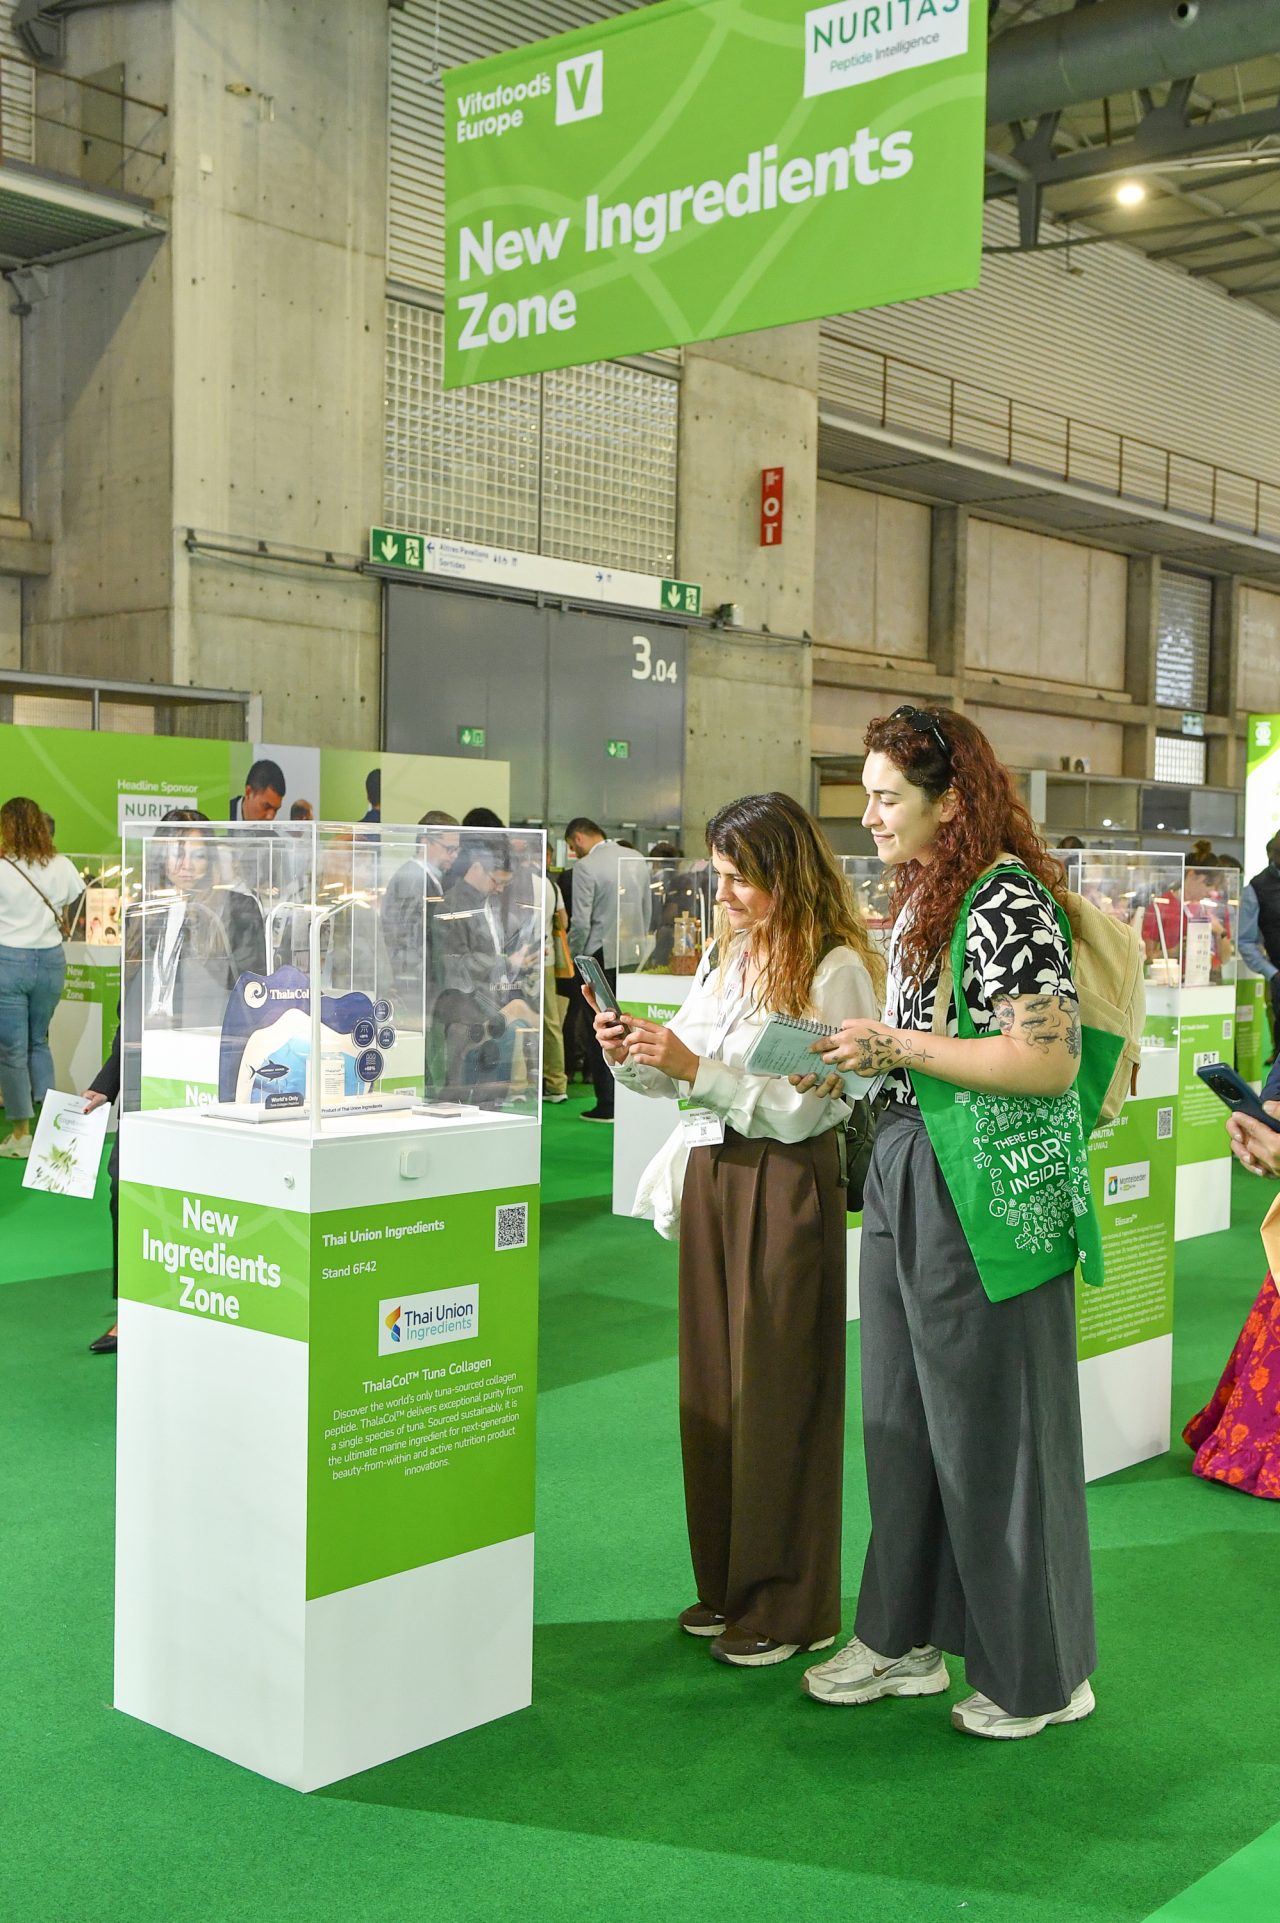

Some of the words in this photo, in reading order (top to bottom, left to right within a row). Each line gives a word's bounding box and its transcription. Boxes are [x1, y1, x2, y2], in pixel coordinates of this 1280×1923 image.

[830, 51, 873, 72] Peptide
[875, 32, 940, 60] Intelligence
[457, 109, 524, 144] Europe
[458, 217, 570, 281] New
[585, 126, 914, 254] Ingredients
[457, 289, 577, 351] Zone
[631, 635, 678, 683] 3.04
[117, 779, 159, 791] Headline
[161, 781, 198, 793] Sponsor
[66, 965, 84, 976] New
[66, 989, 84, 1000] Zone
[647, 1004, 676, 1020] New
[1203, 1053, 1216, 1064] PLT
[993, 1132, 1027, 1151] THERE
[1028, 1129, 1039, 1140] IS
[1040, 1127, 1047, 1137] A
[1009, 1161, 1066, 1195] INSIDE
[182, 1197, 239, 1238] New
[322, 1231, 347, 1247] Thai
[349, 1228, 382, 1243] Union
[385, 1219, 445, 1239] Ingredients
[142, 1228, 282, 1288] Ingredients
[322, 1264, 350, 1279] Stand
[352, 1260, 377, 1275] 6F42
[179, 1275, 240, 1320] Zone
[404, 1307, 433, 1326] Thai
[436, 1302, 473, 1321] Union
[406, 1319, 472, 1340] Ingredients
[362, 1371, 419, 1393] ThalaCol™
[421, 1368, 446, 1380] Tuna
[449, 1358, 492, 1375] Collagen
[324, 1422, 358, 1440] peptide.
[360, 1410, 405, 1429] ThalaCol™
[406, 1404, 437, 1418] delivers
[439, 1392, 482, 1411] exceptional
[483, 1389, 505, 1403] purity
[506, 1384, 523, 1396] from
[333, 1405, 368, 1421] Discover
[370, 1401, 384, 1412] the
[386, 1393, 415, 1408] world's
[416, 1390, 434, 1402] only
[435, 1379, 484, 1397] tuna-sourced
[485, 1372, 517, 1385] collagen
[328, 1455, 342, 1466] the
[344, 1447, 378, 1462] ultimate
[379, 1439, 407, 1454] marine
[408, 1430, 448, 1447] ingredient
[449, 1426, 460, 1437] for
[461, 1412, 520, 1433] next-generation
[331, 1443, 337, 1451] a
[338, 1434, 363, 1449] single
[365, 1428, 395, 1443] species
[396, 1423, 405, 1434] of
[406, 1421, 426, 1433] tuna.
[428, 1411, 459, 1427] Sourced
[461, 1402, 503, 1420] sustainably,
[505, 1399, 510, 1409] it
[511, 1399, 518, 1408] is
[332, 1452, 411, 1480] beauty-from-within
[413, 1447, 428, 1460] and
[430, 1443, 453, 1455] active
[454, 1434, 486, 1449] nutrition
[487, 1426, 516, 1443] product
[404, 1458, 450, 1476] innovations.
